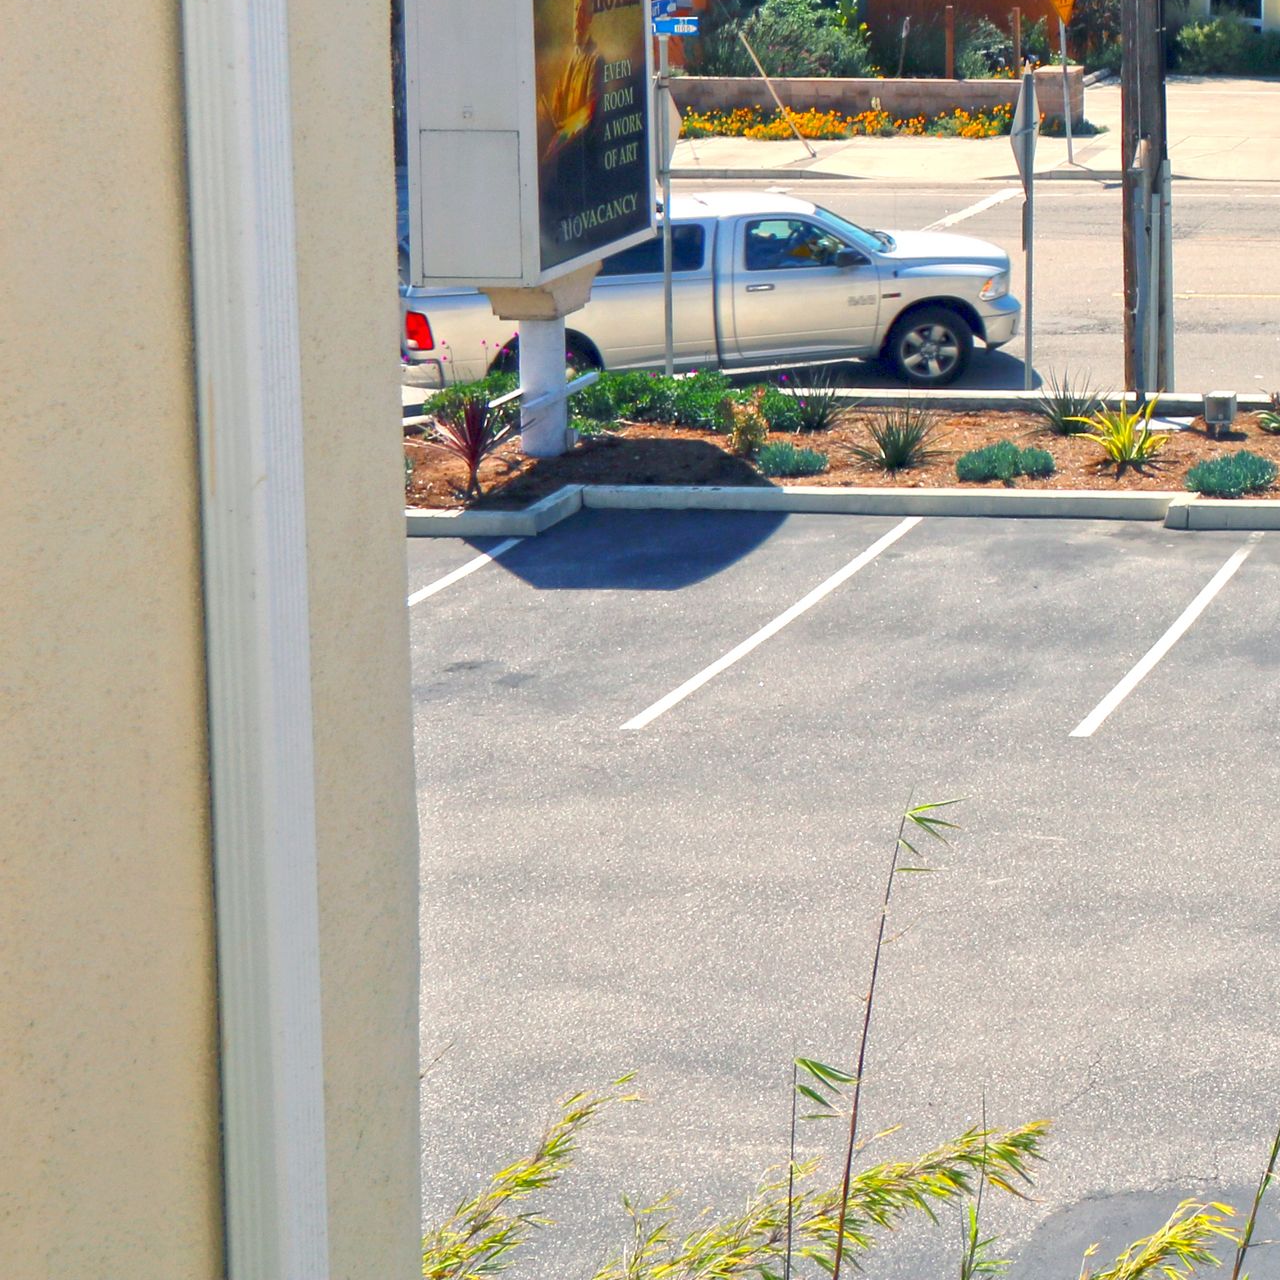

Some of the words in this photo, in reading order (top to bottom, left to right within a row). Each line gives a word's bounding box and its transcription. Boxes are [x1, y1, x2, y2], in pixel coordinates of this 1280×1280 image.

[604, 59, 632, 82] EVERY
[604, 87, 634, 112] ROOM
[604, 122, 611, 141] A
[613, 112, 643, 137] WORK
[604, 148, 618, 170] OF
[619, 142, 638, 165] ART
[580, 192, 638, 229] VACANCY
